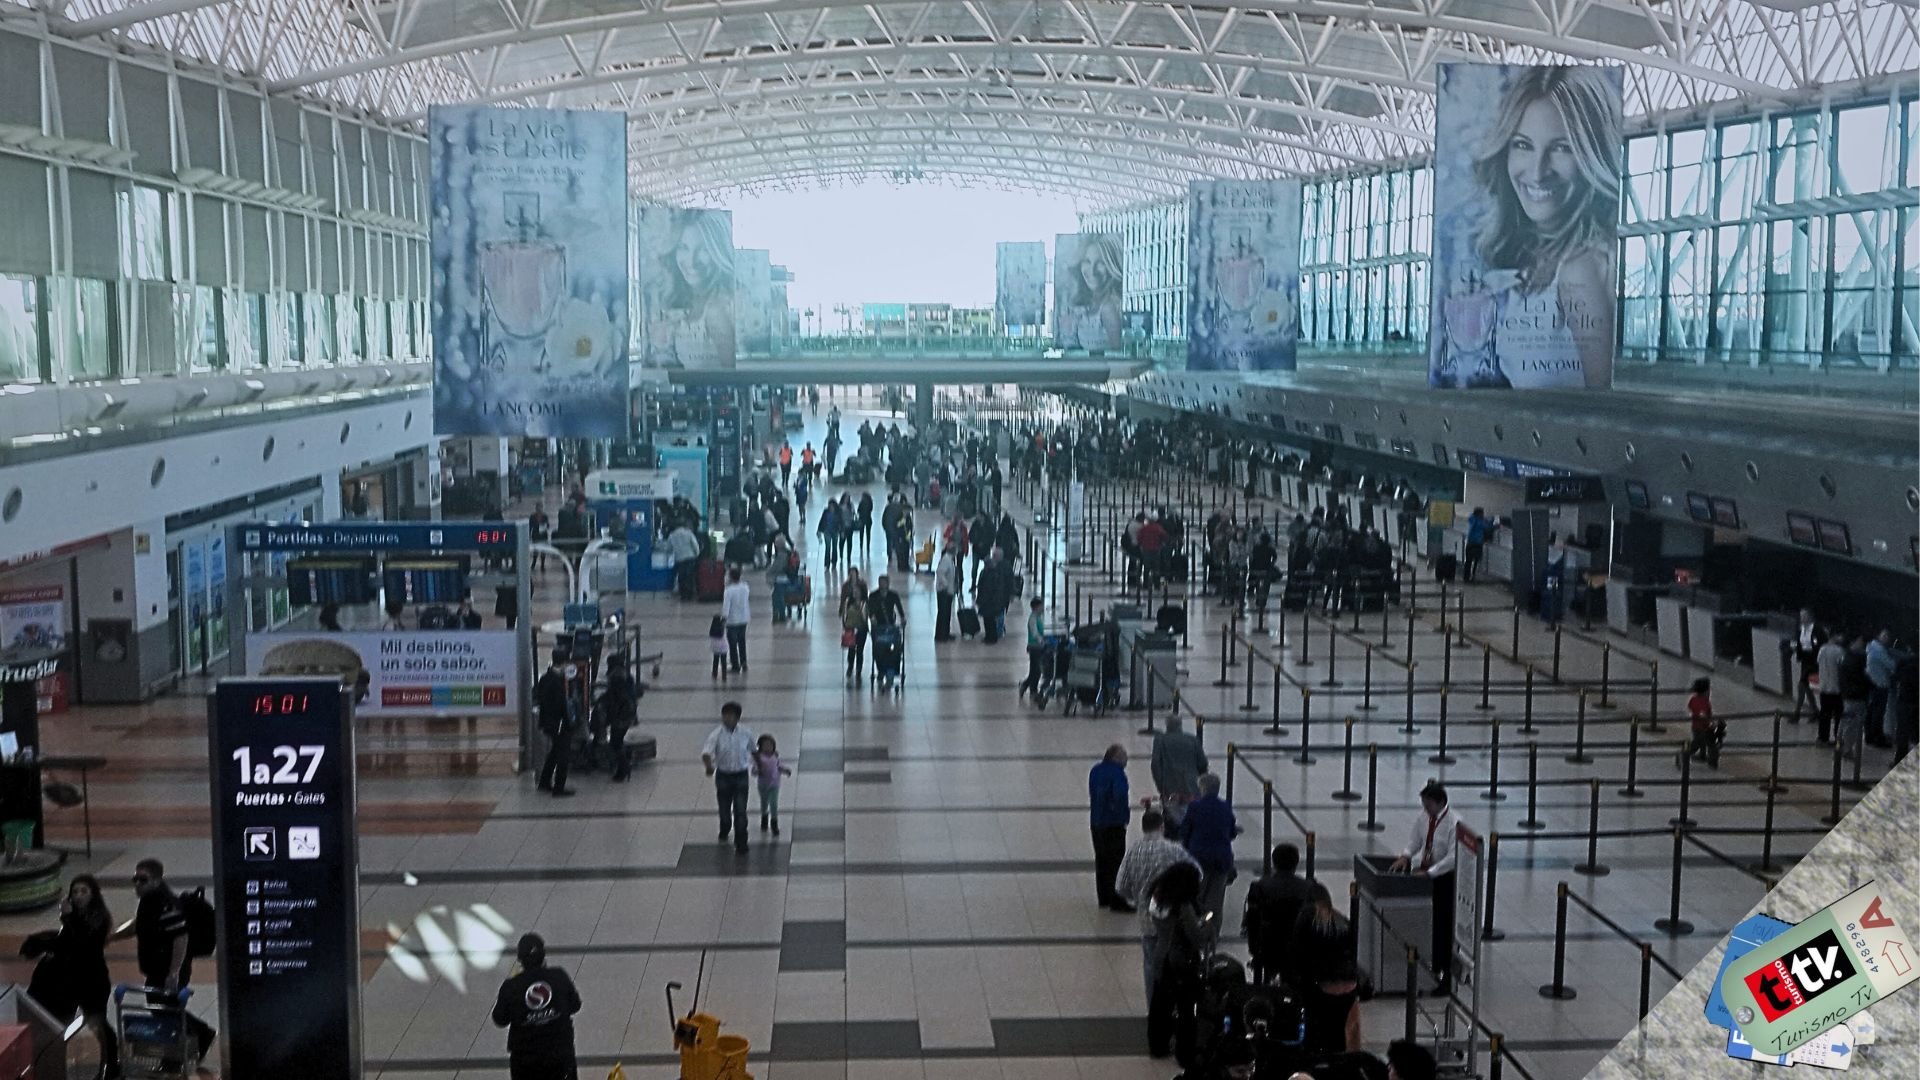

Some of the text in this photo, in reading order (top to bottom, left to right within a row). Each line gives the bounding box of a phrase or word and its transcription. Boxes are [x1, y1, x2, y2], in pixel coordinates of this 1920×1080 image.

[523, 138, 588, 161] belle
[1505, 315, 1545, 331] est
[267, 530, 400, 546] Partidas Departures
[380, 638, 475, 656] Mil destinos,
[380, 655, 487, 671] un solo sabor.
[236, 790, 326, 806] Puertas Gates
